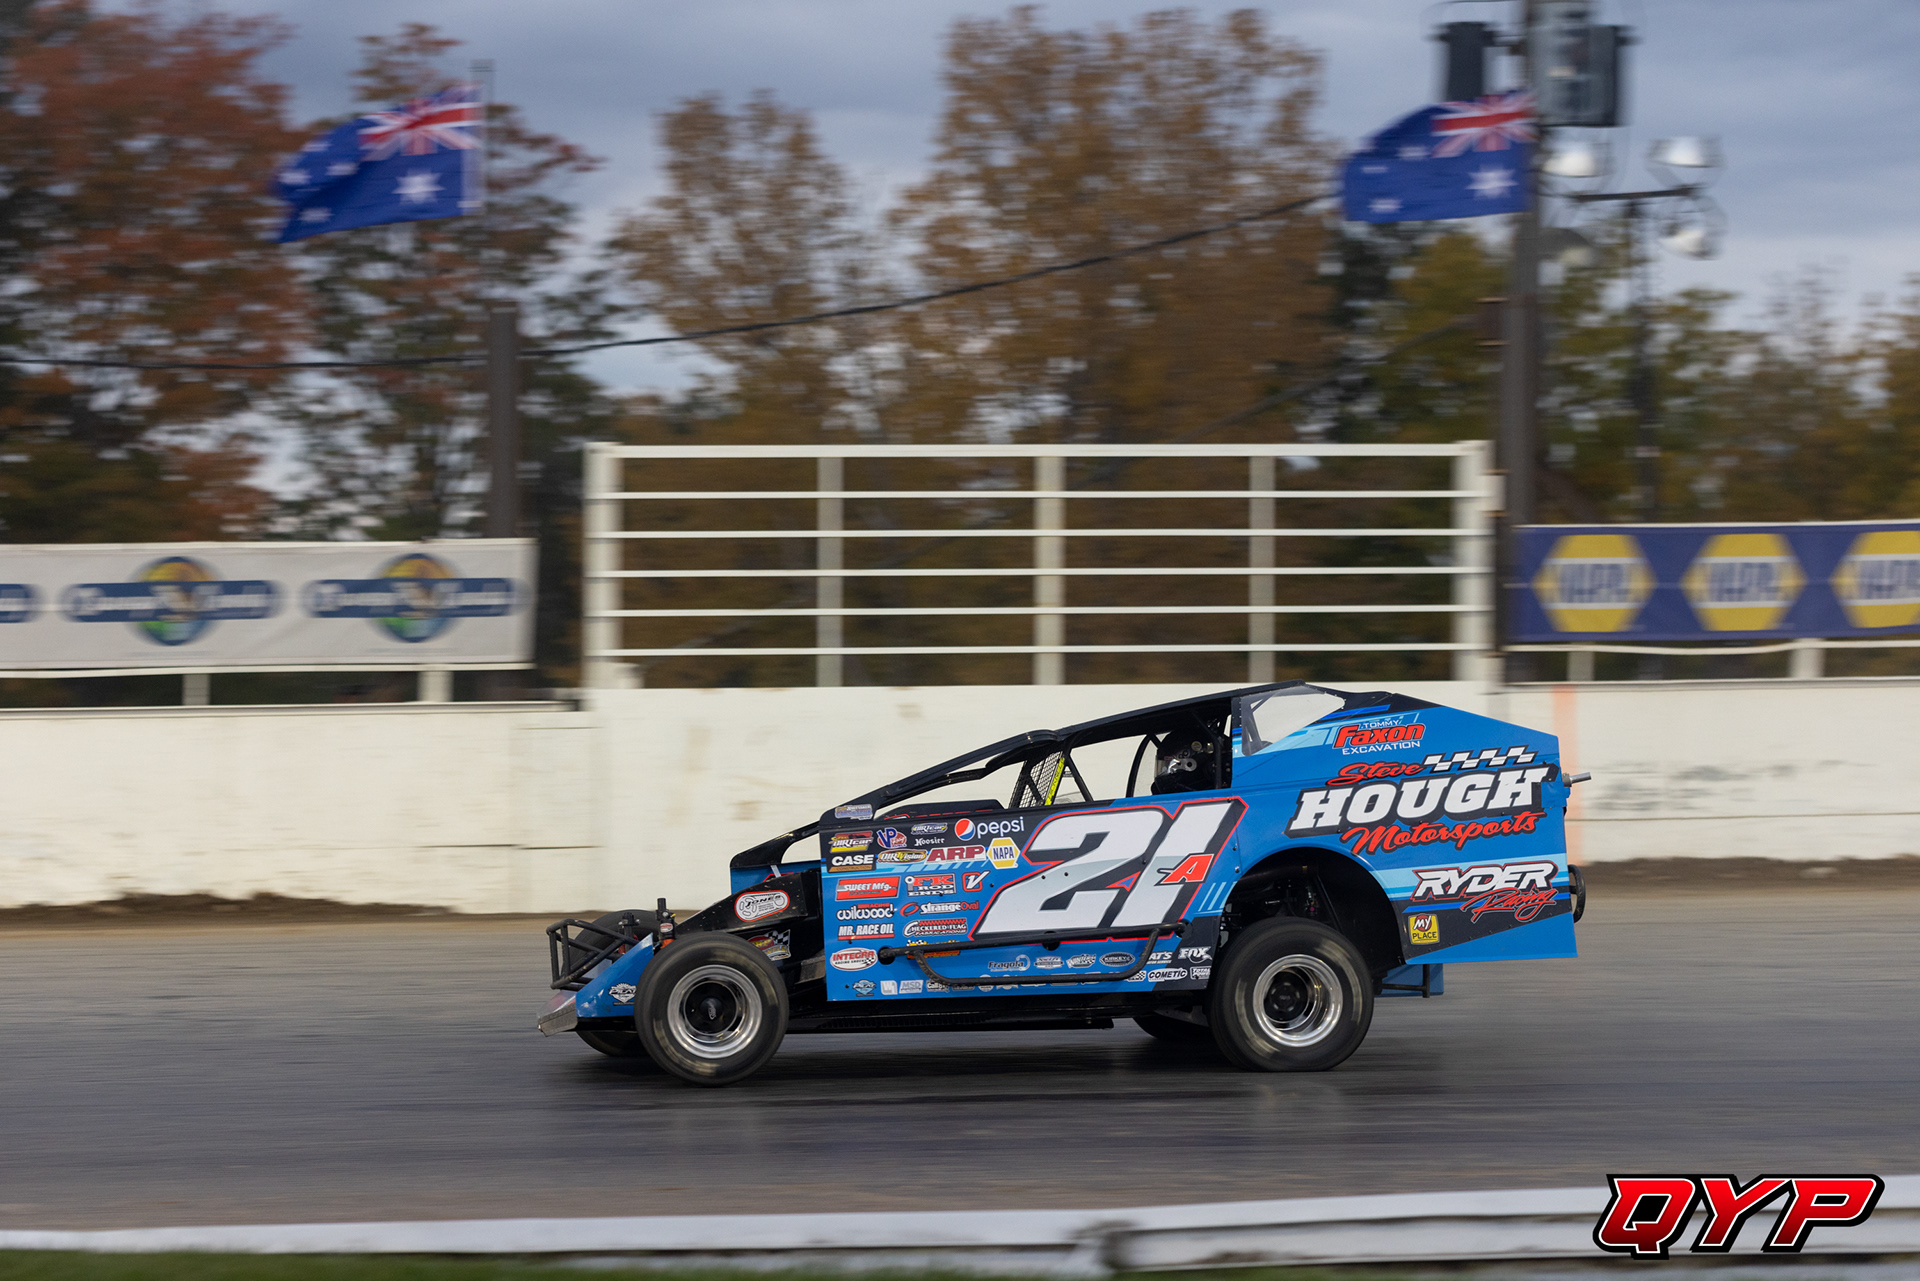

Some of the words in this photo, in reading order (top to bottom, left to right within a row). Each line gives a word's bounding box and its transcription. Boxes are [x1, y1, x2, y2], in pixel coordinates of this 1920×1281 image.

[1363, 720, 1399, 730] TOMMY
[1334, 723, 1425, 749] Faxon
[1342, 740, 1421, 755] EXCAVATION
[1327, 762, 1423, 786] Steve
[1289, 767, 1549, 830] HOUGH
[976, 816, 1025, 839] pepsi
[1342, 811, 1546, 855] Motorsports
[831, 854, 874, 866] CASE
[926, 847, 985, 862] ARP
[992, 846, 1015, 860] NAPA
[976, 802, 1233, 934] 21
[913, 876, 954, 886] FK
[1412, 862, 1554, 897] RYDER
[843, 883, 872, 892] SWEET
[837, 903, 893, 920] wilwood
[1460, 888, 1558, 923] Racing
[838, 925, 855, 936] MR.
[856, 924, 880, 936] RACE
[881, 923, 894, 934] OIL
[1412, 931, 1438, 940] PLACE
[832, 950, 875, 961] INTEGRA
[1148, 951, 1173, 960] AT'S
[988, 961, 1024, 969] Fragola
[1148, 968, 1187, 978] COMETIC
